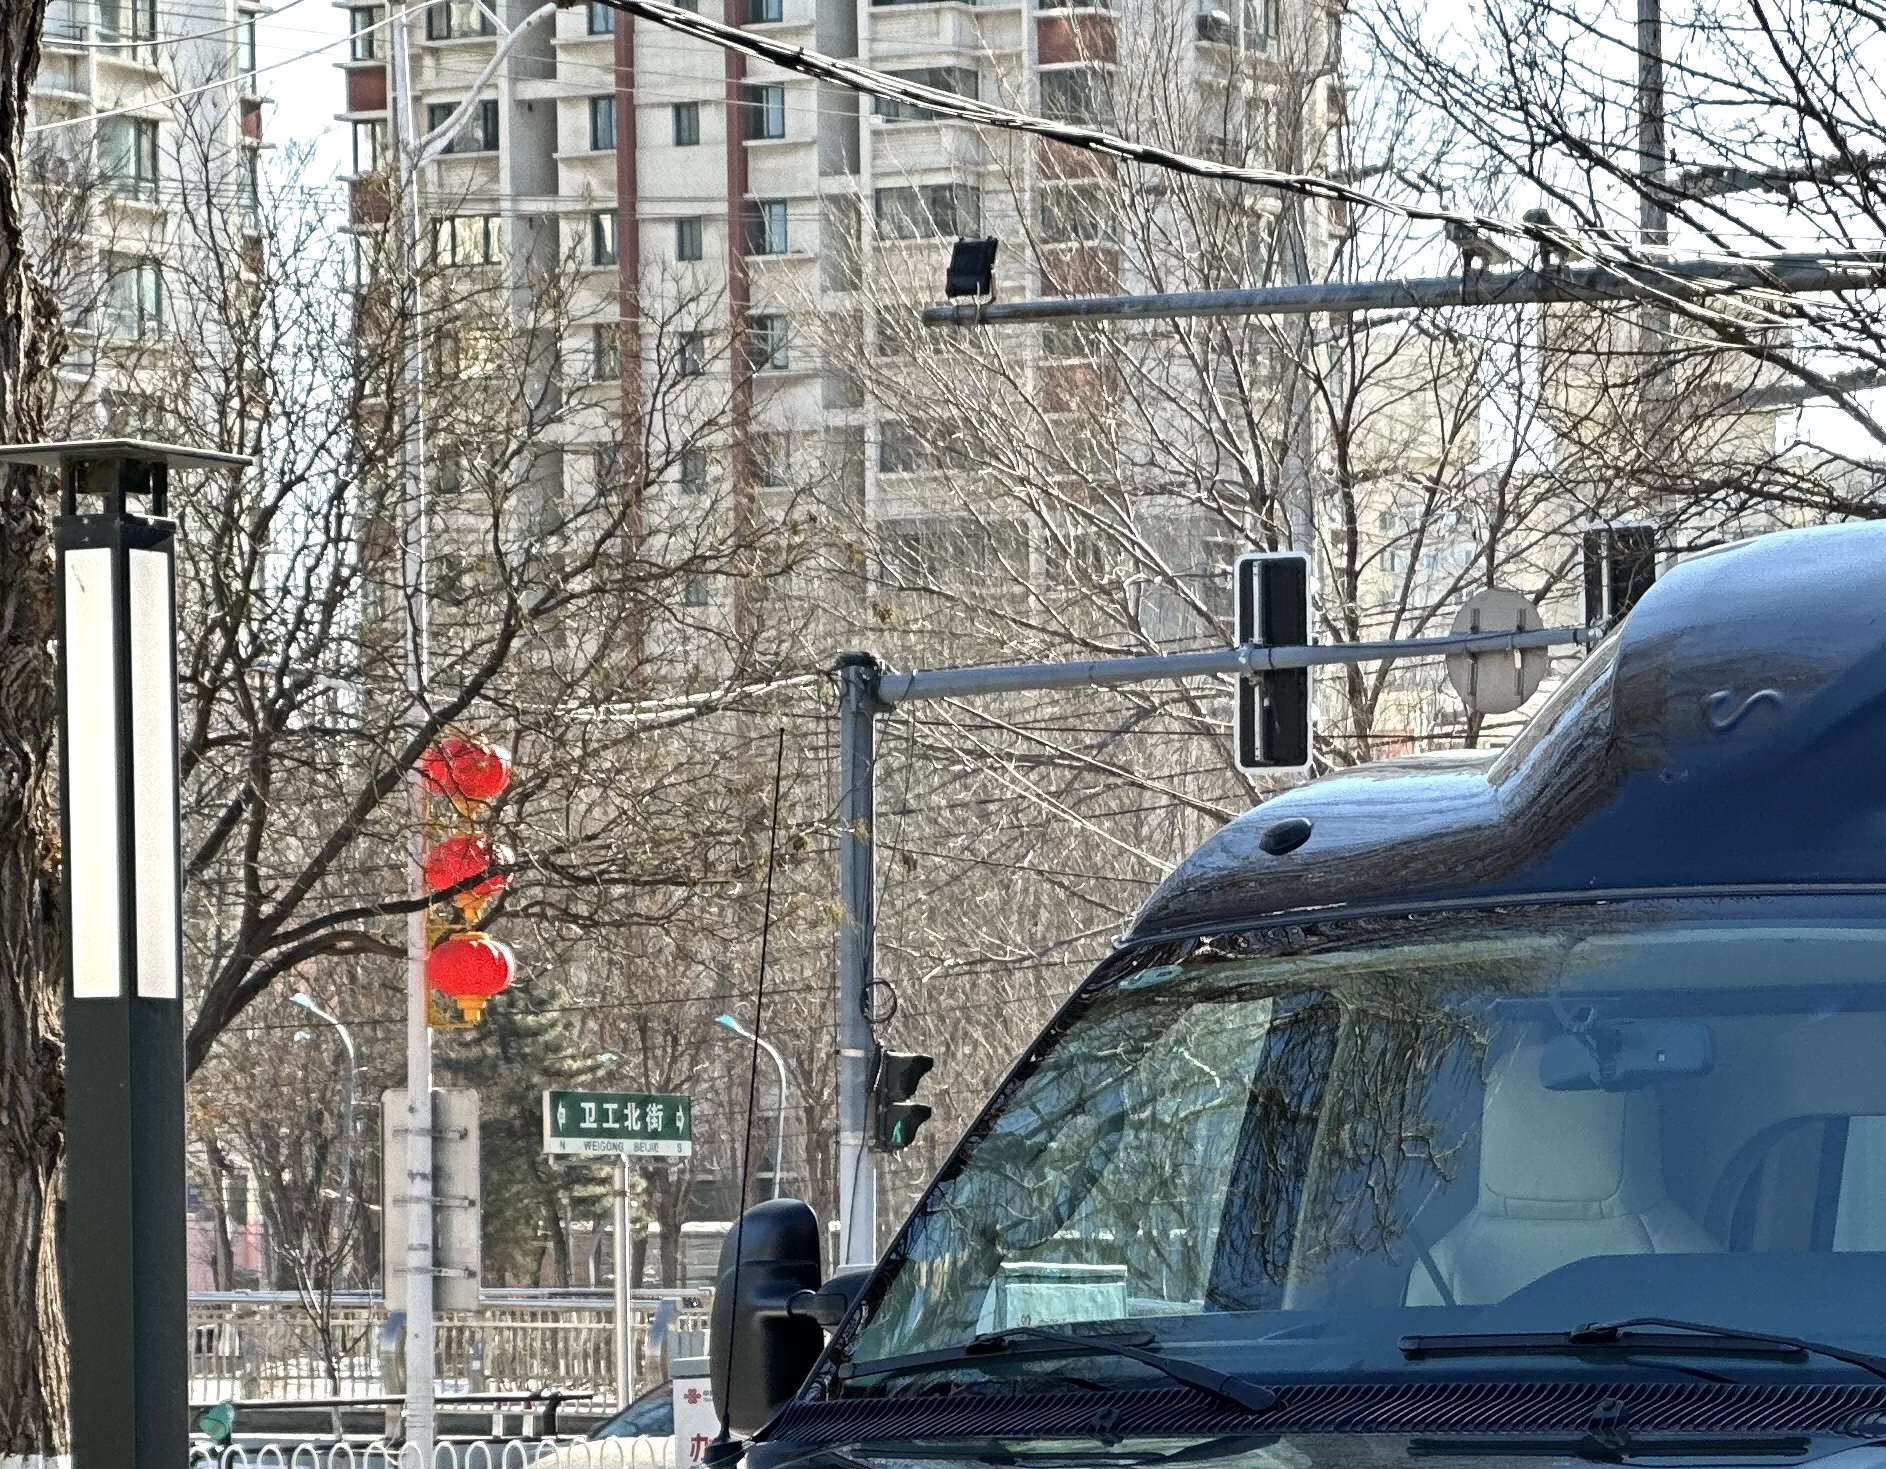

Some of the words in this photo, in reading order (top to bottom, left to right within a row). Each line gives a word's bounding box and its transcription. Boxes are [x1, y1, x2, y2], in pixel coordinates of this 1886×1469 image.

[579, 1101, 664, 1132] 卫工北街
[559, 1140, 566, 1151] N
[583, 1140, 625, 1152] WEIGONG
[676, 1142, 683, 1153] S
